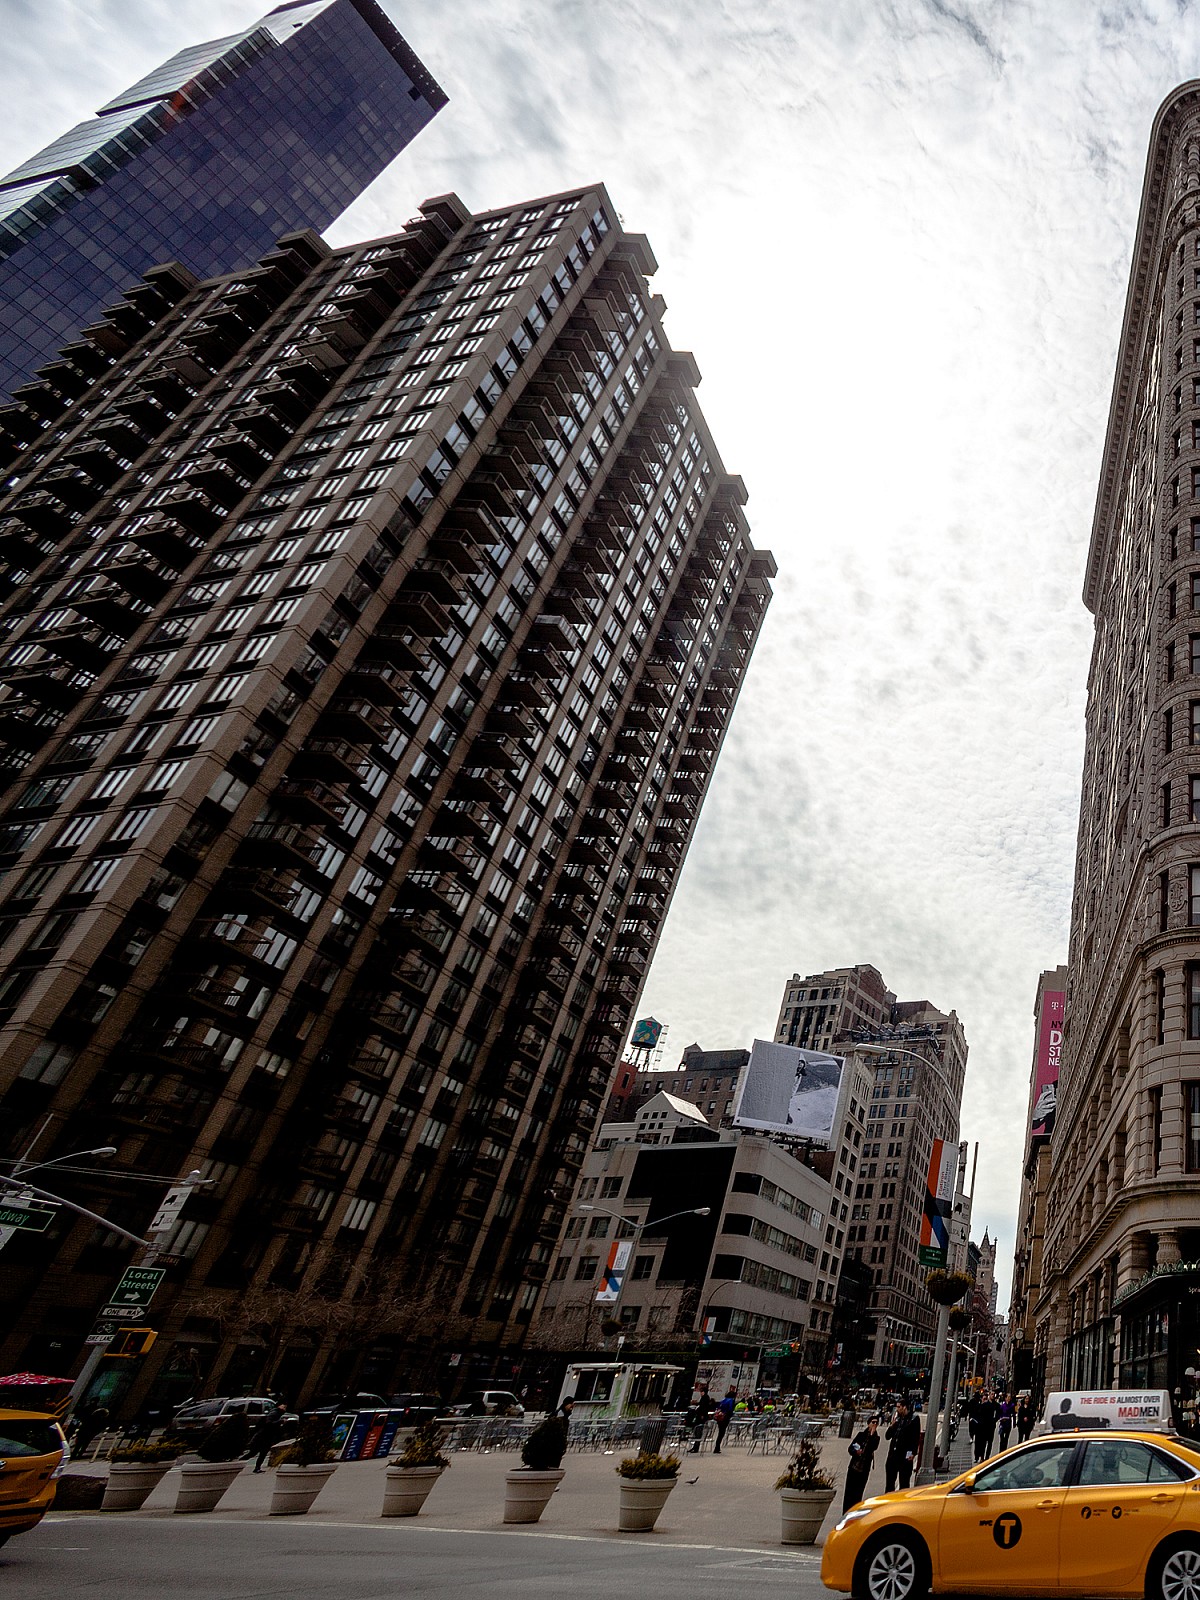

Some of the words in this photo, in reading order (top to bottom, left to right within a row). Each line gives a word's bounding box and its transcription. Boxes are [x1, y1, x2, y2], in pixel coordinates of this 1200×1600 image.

[128, 1271, 158, 1280] Local
[120, 1280, 156, 1290] Streets
[106, 1308, 120, 1316] ONE
[1080, 1397, 1092, 1405] THE
[1093, 1397, 1109, 1405] RIDE
[1110, 1396, 1116, 1404] IS
[1116, 1396, 1142, 1404] ALMOST
[1143, 1395, 1160, 1404] OVER
[1000, 1519, 1016, 1545] T
